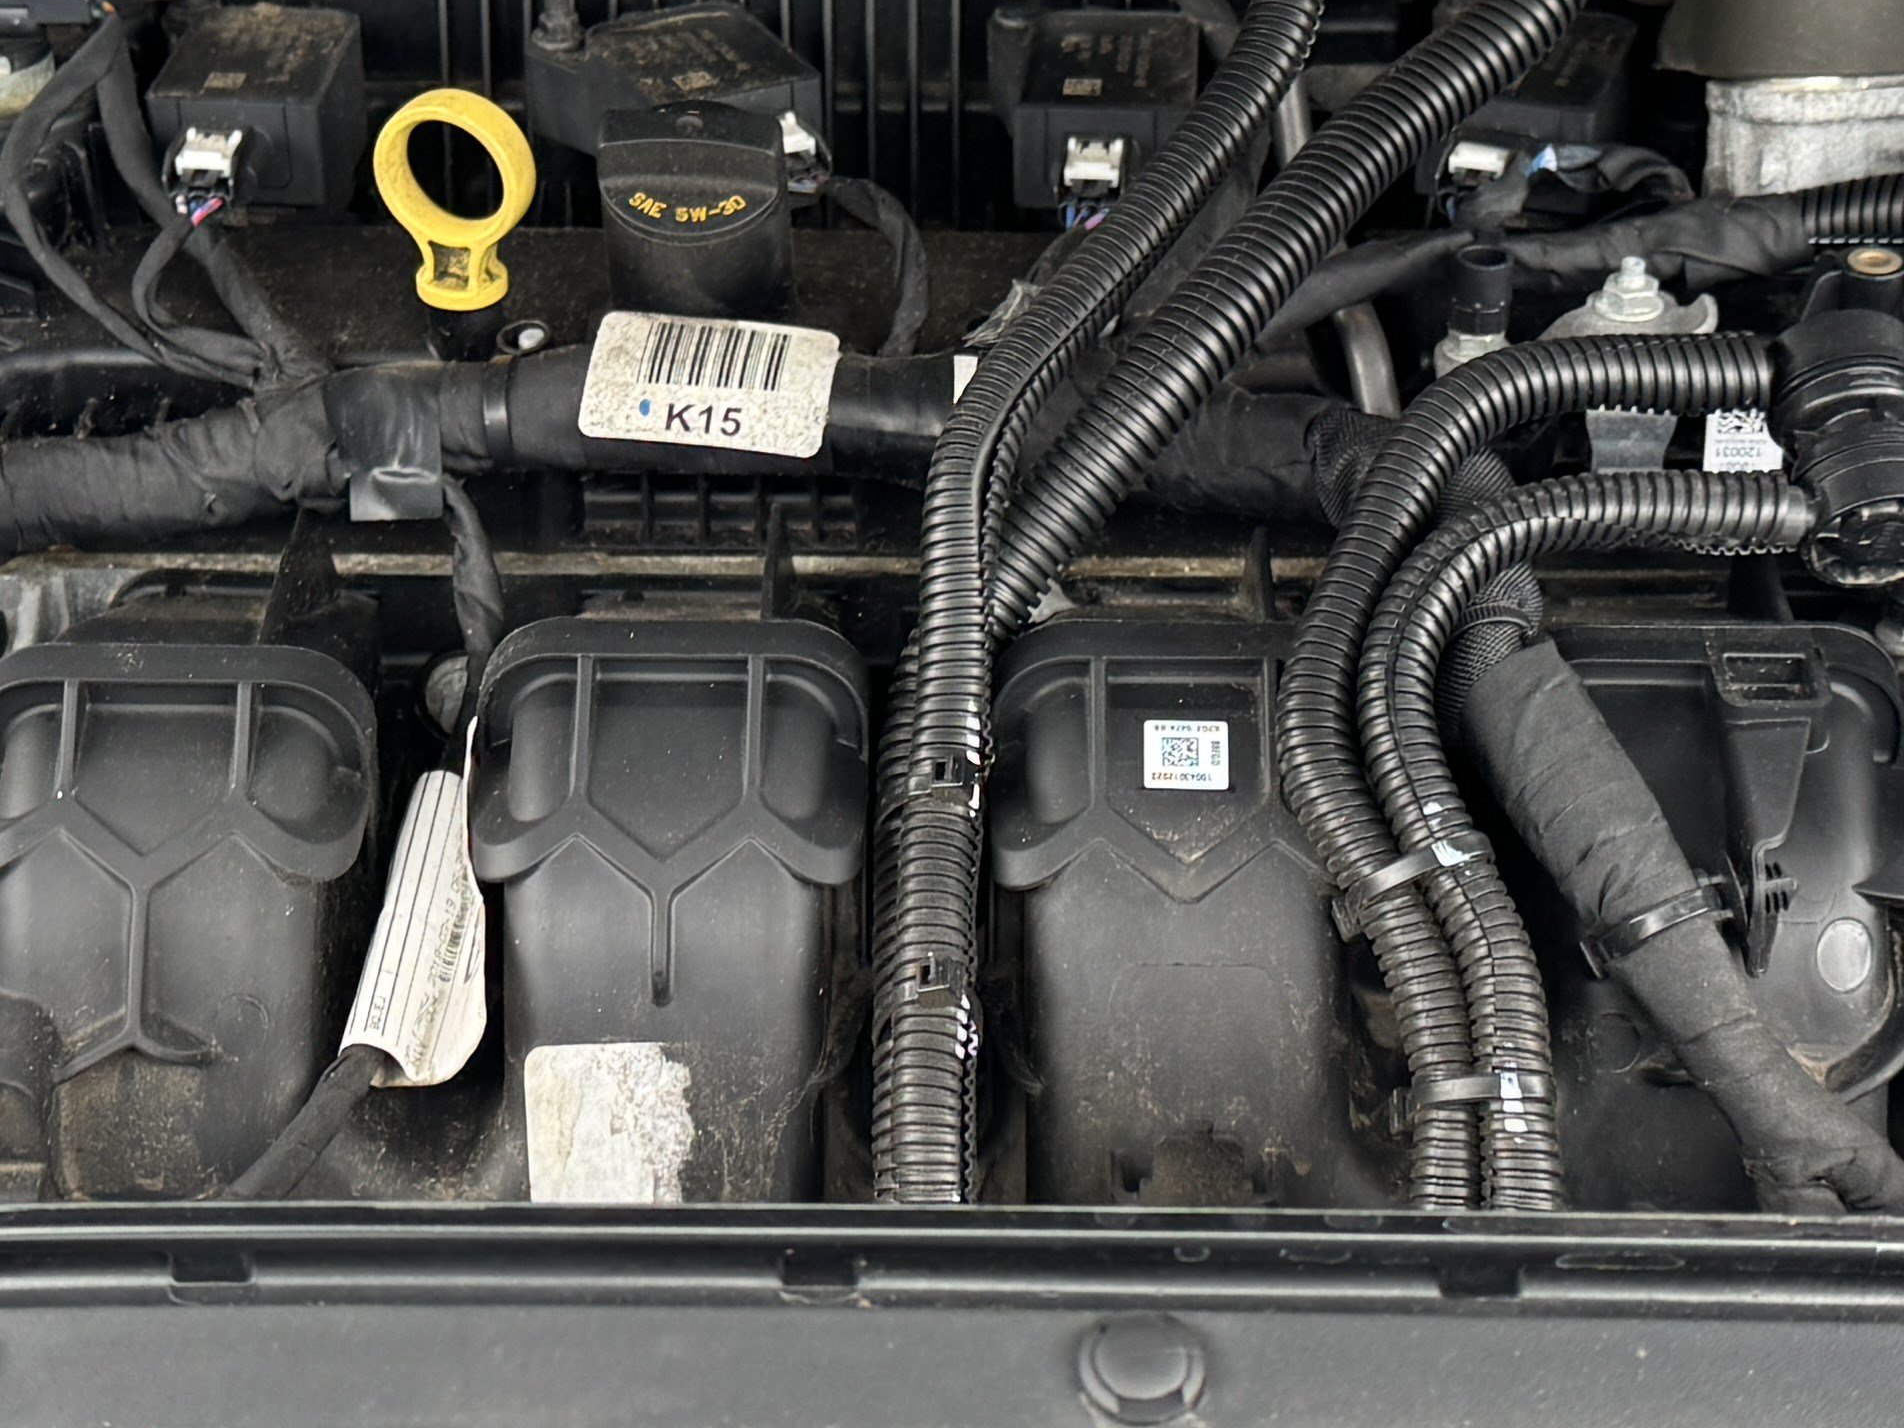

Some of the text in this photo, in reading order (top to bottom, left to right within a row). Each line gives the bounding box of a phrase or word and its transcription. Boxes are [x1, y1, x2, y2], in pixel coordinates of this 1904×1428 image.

[628, 191, 747, 223] SAE 5W-30
[664, 403, 743, 437] K15
